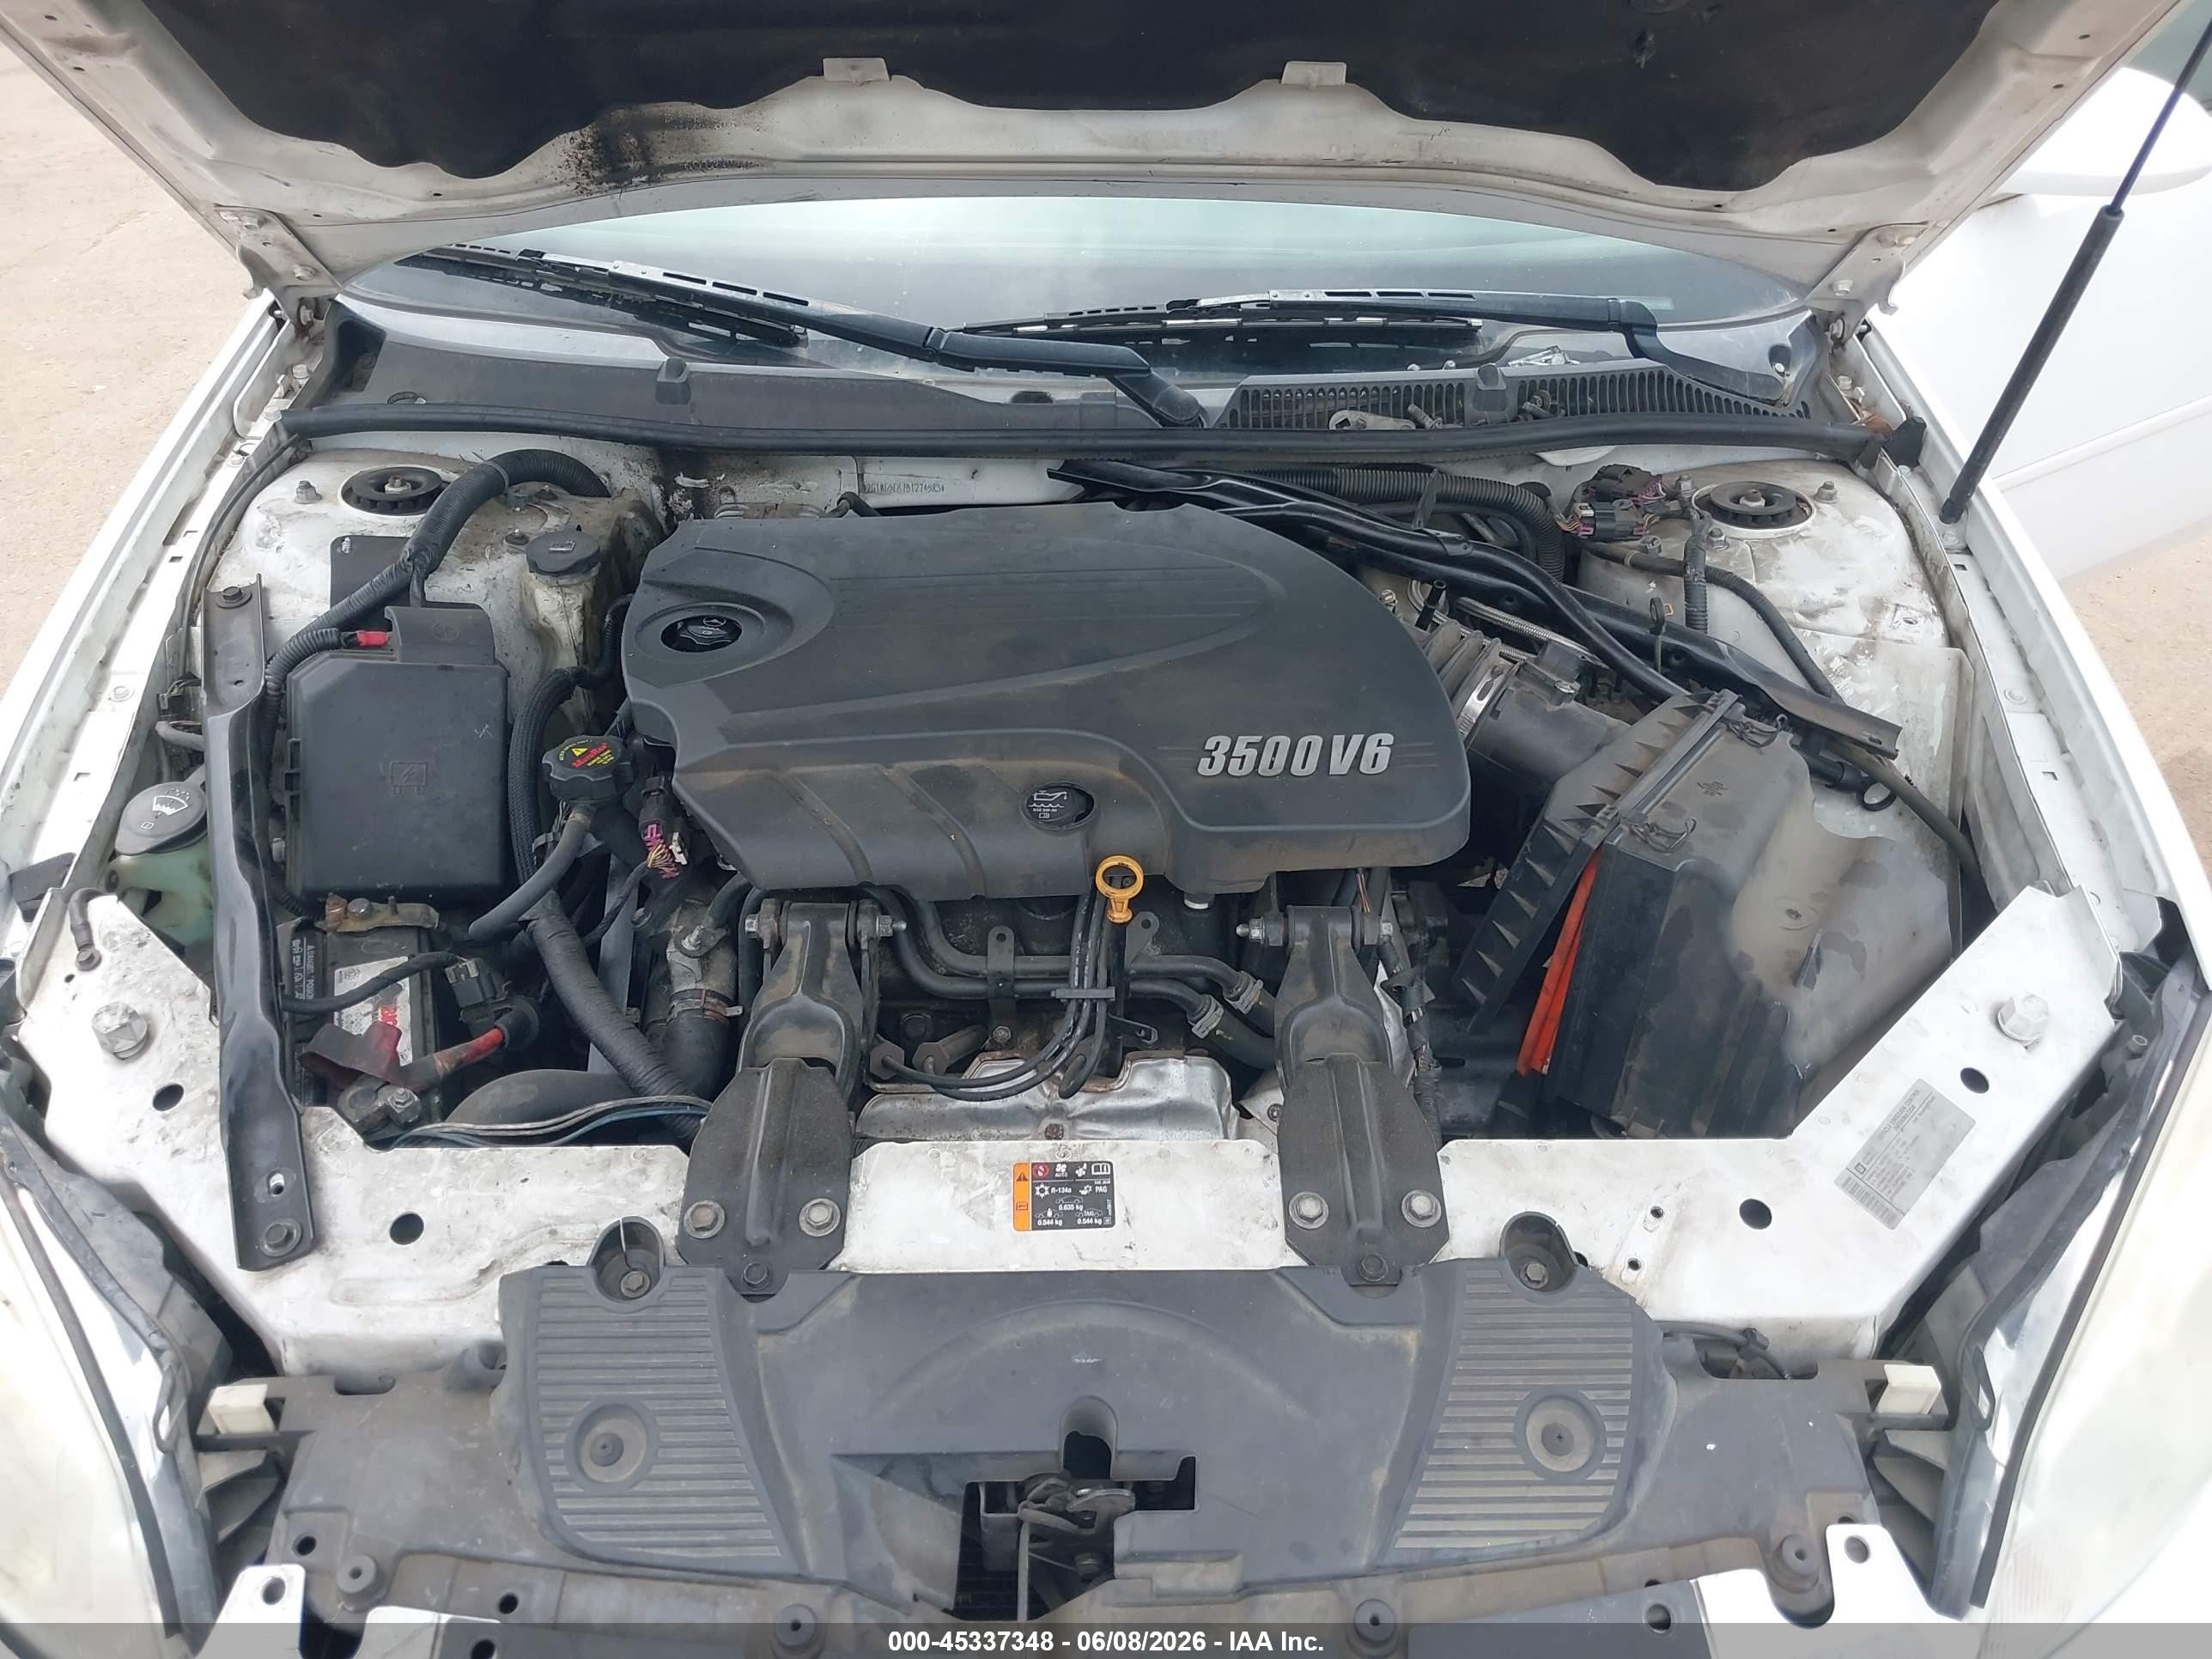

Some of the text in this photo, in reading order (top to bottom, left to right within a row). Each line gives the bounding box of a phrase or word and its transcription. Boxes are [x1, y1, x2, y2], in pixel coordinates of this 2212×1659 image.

[1197, 732, 1395, 776] 3500 V6
[1075, 1203, 1084, 1212] kg
